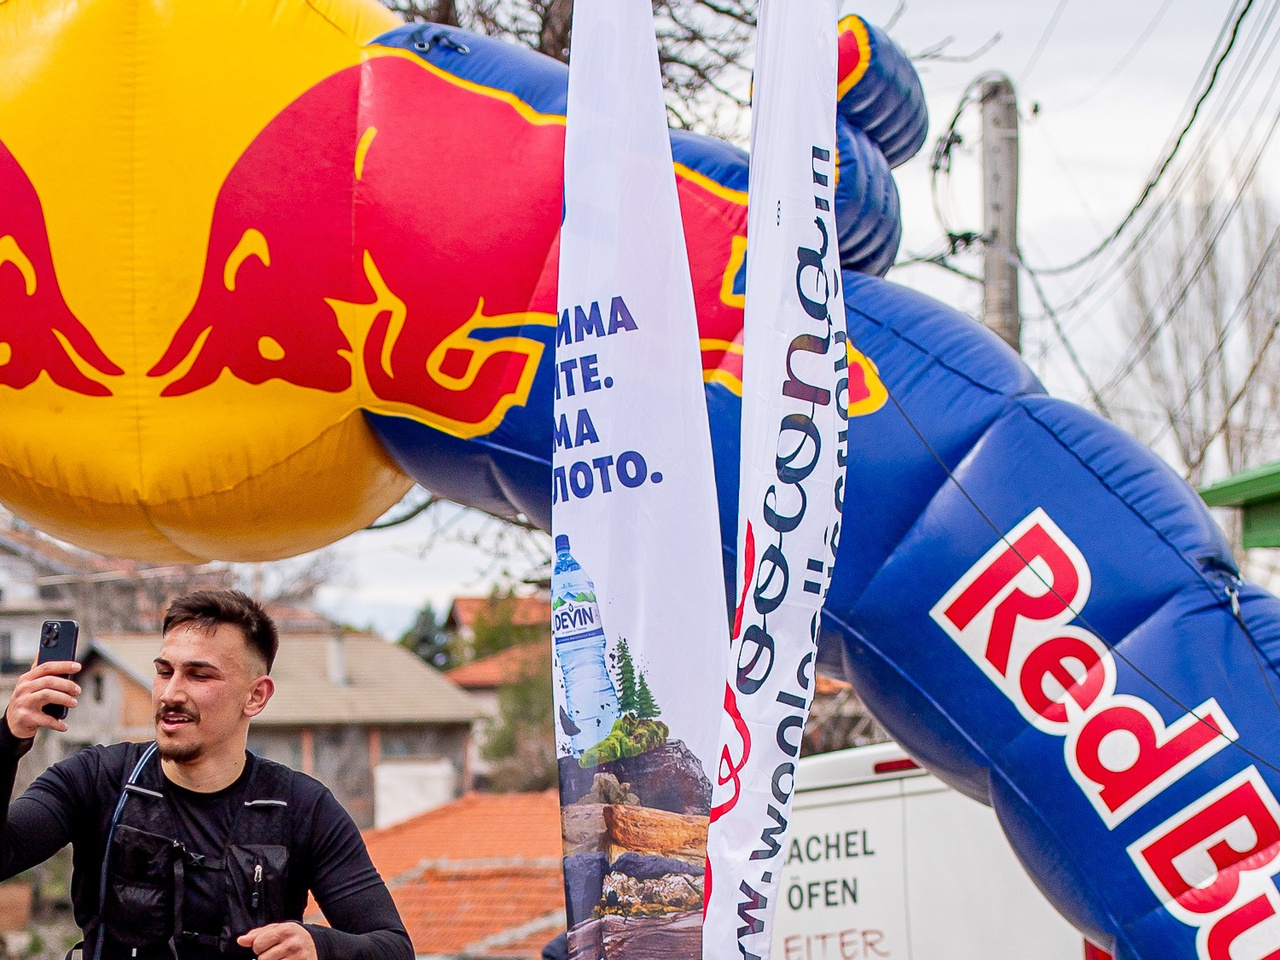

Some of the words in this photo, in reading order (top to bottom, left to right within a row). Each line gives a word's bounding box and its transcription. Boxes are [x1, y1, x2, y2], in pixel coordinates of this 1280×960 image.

[555, 606, 595, 632] DEVIN
[929, 507, 1239, 831] Red
[783, 829, 875, 866] ACHEL
[788, 876, 858, 911] ÖFEN
